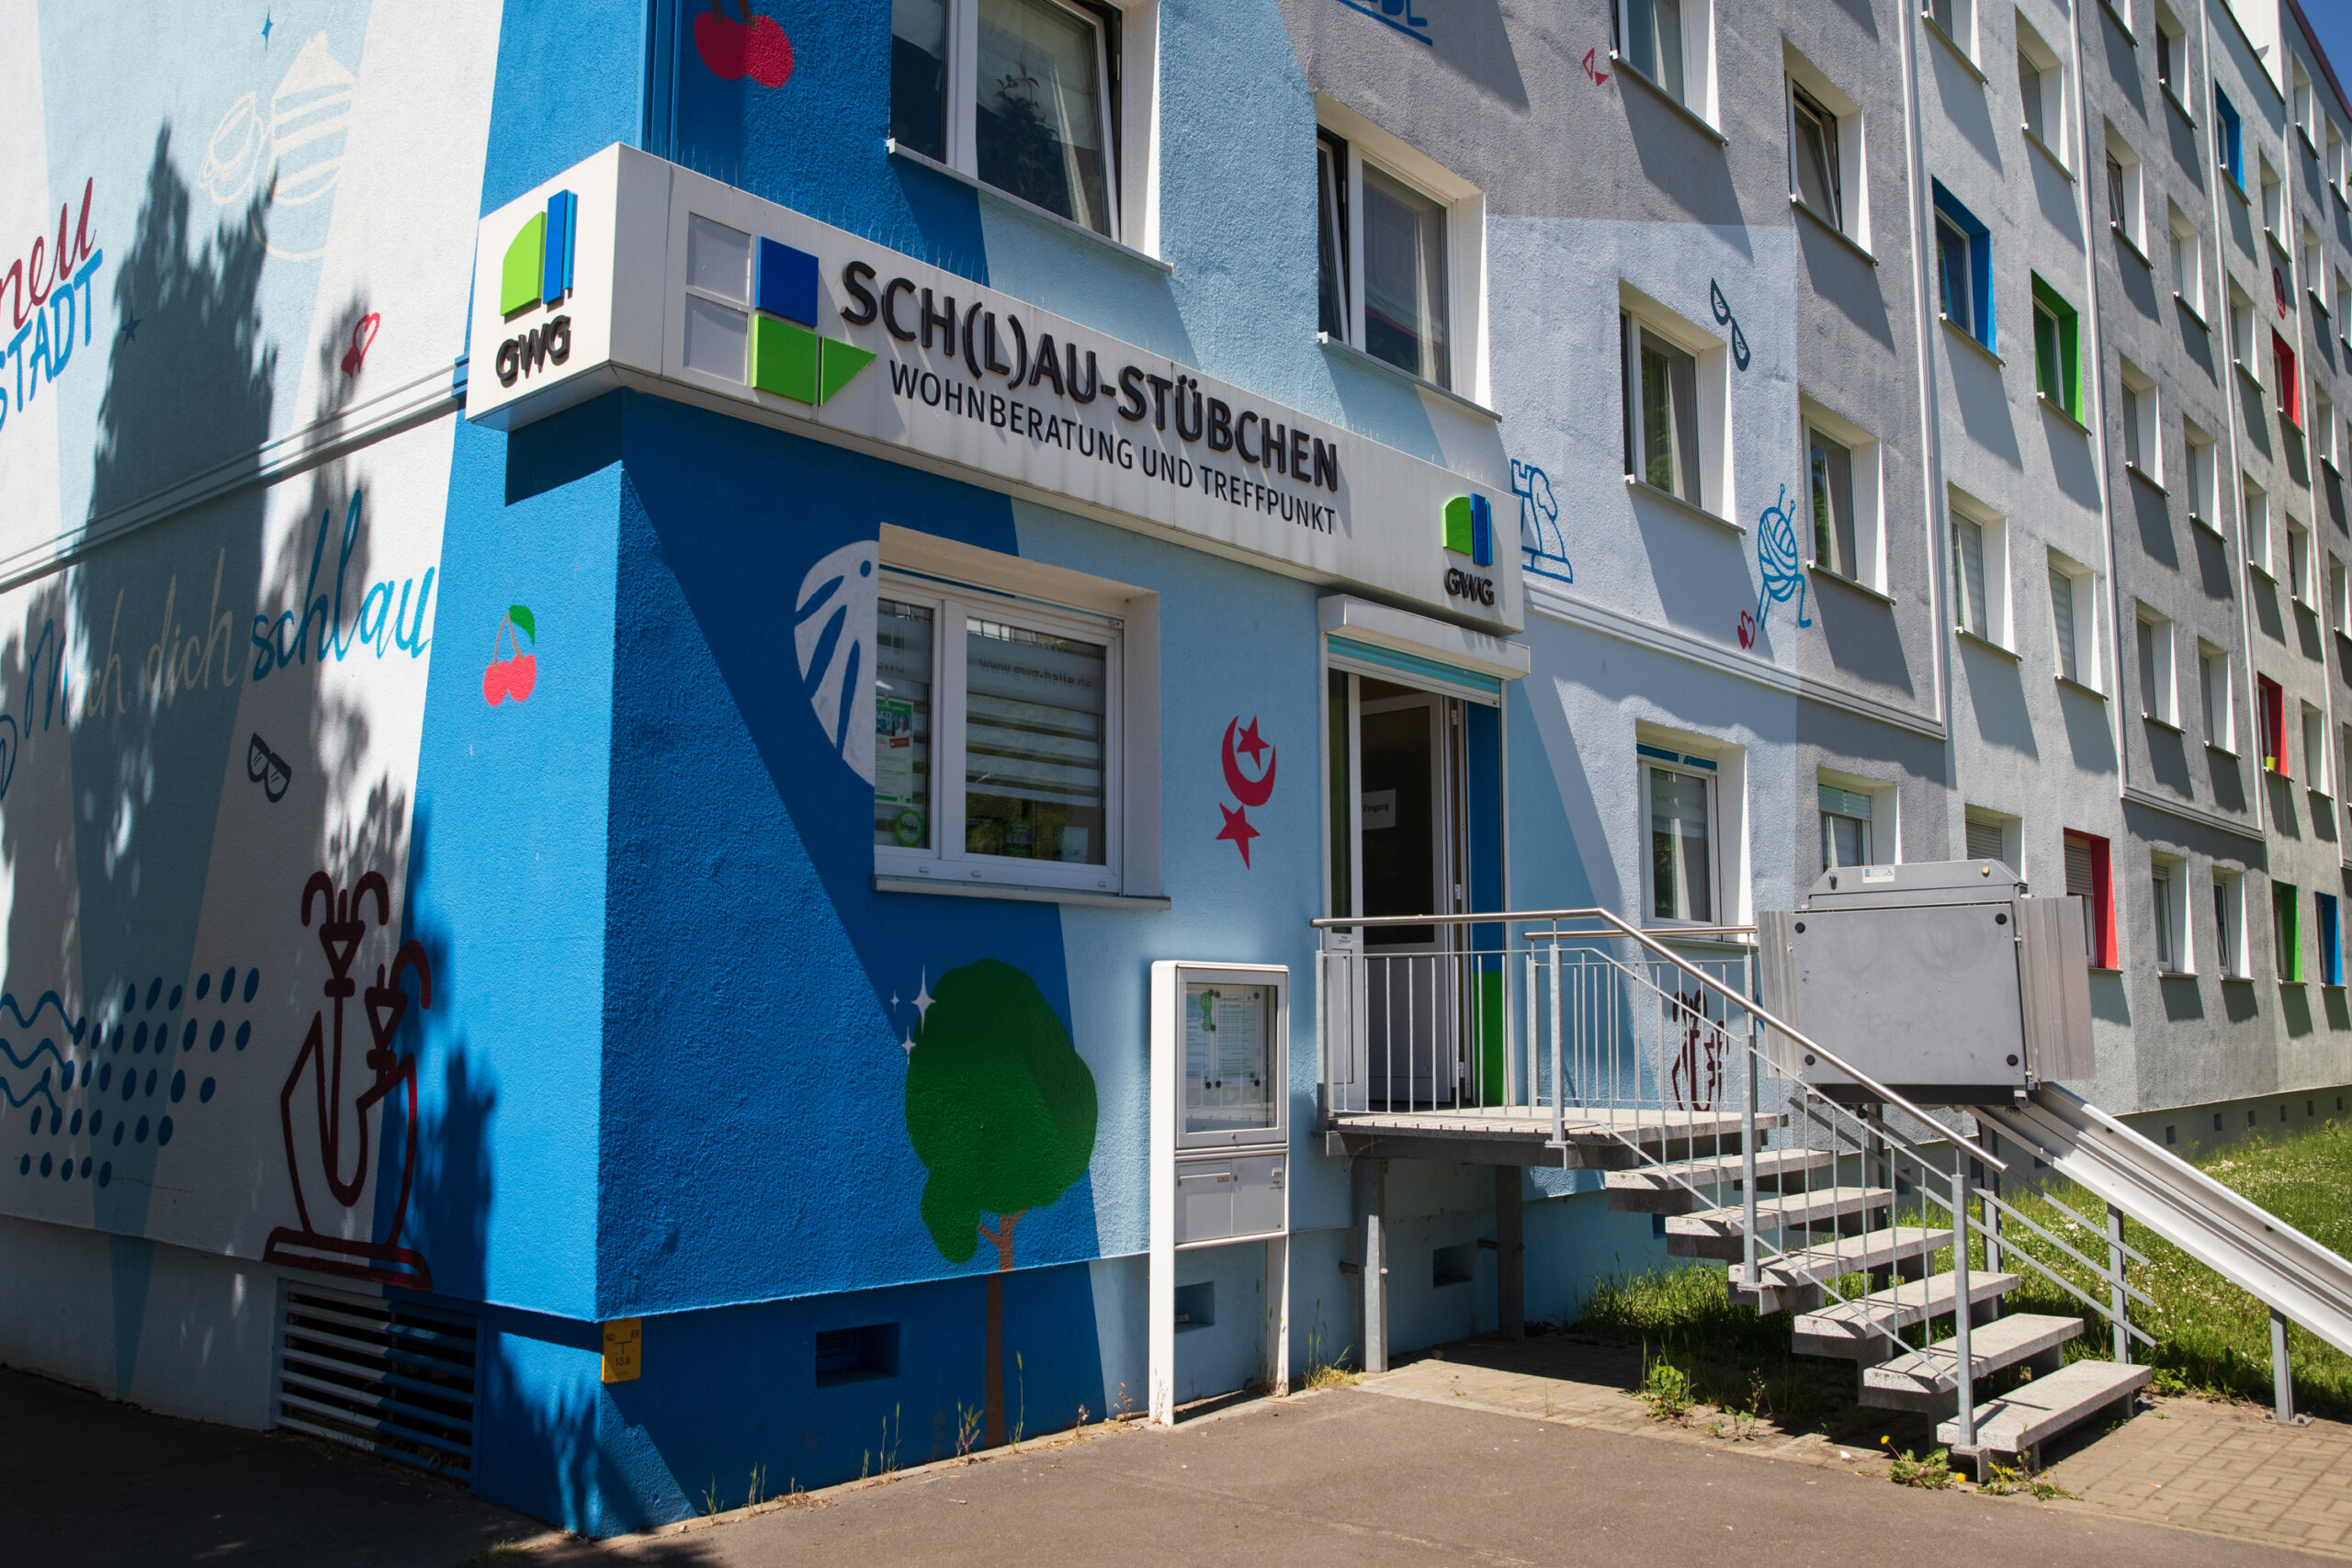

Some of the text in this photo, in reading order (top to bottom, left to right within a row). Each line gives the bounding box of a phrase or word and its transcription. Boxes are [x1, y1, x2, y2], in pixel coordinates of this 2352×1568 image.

[495, 314, 571, 388] GWG
[841, 261, 1338, 492] SCH(L)AU-STÜBCHEN
[889, 359, 1336, 535] WOHNBERATUNG UND TREFFPUNKT
[145, 547, 241, 701] dich
[250, 489, 436, 682] schlau
[1443, 567, 1495, 607] GWG
[1363, 802, 1390, 814] Eingang
